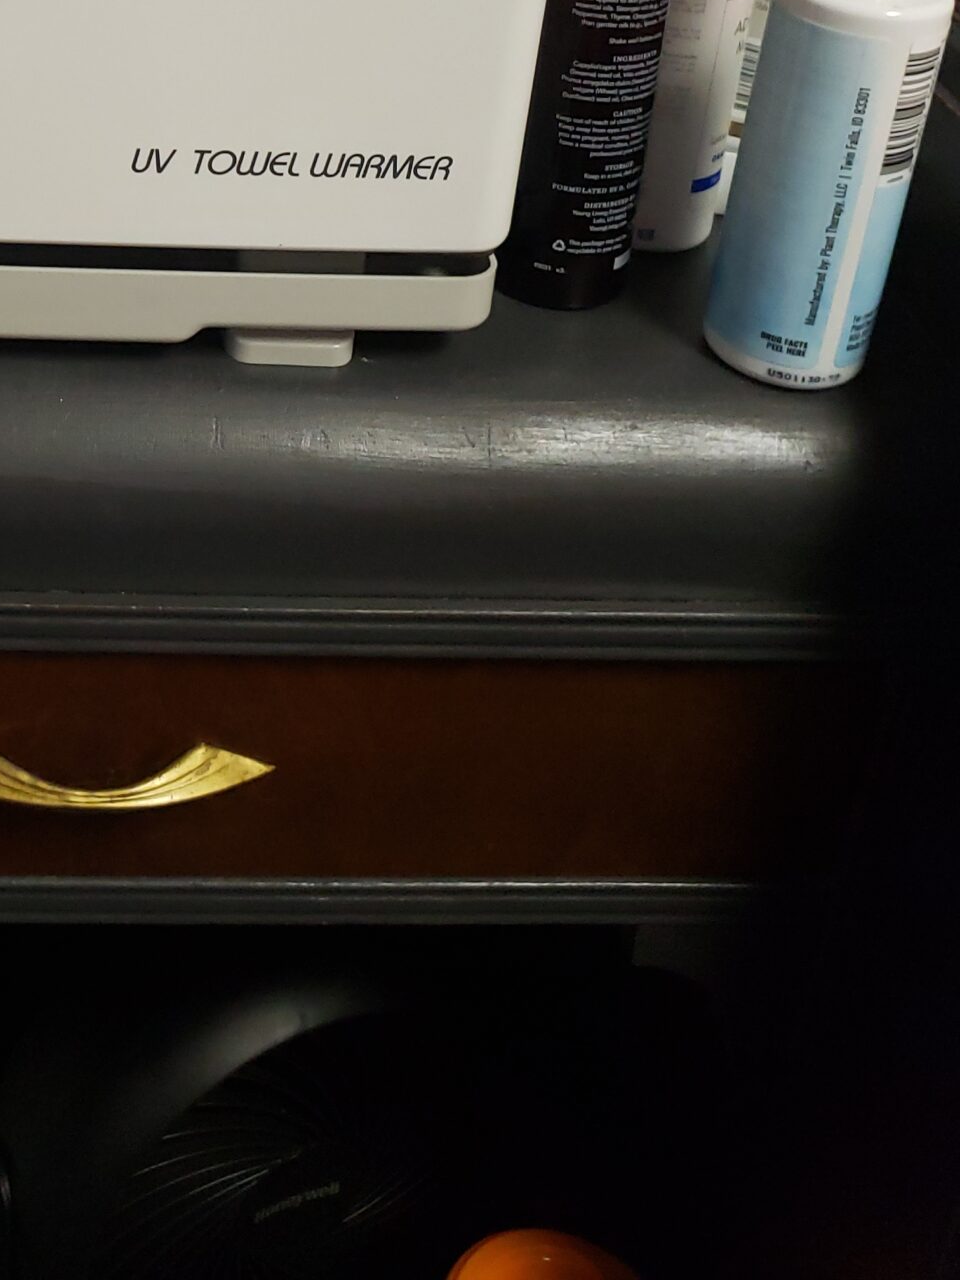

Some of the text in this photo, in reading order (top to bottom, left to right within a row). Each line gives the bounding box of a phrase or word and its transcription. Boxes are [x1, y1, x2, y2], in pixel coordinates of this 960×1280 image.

[853, 86, 872, 116] 83301
[851, 115, 865, 127] ID
[131, 148, 454, 181] UV TOWEL WARMER
[840, 150, 856, 172] Twin
[552, 182, 608, 194] FORMULATED
[834, 182, 849, 199] LLC
[819, 234, 836, 258] Plant
[784, 338, 808, 349] FACTS
